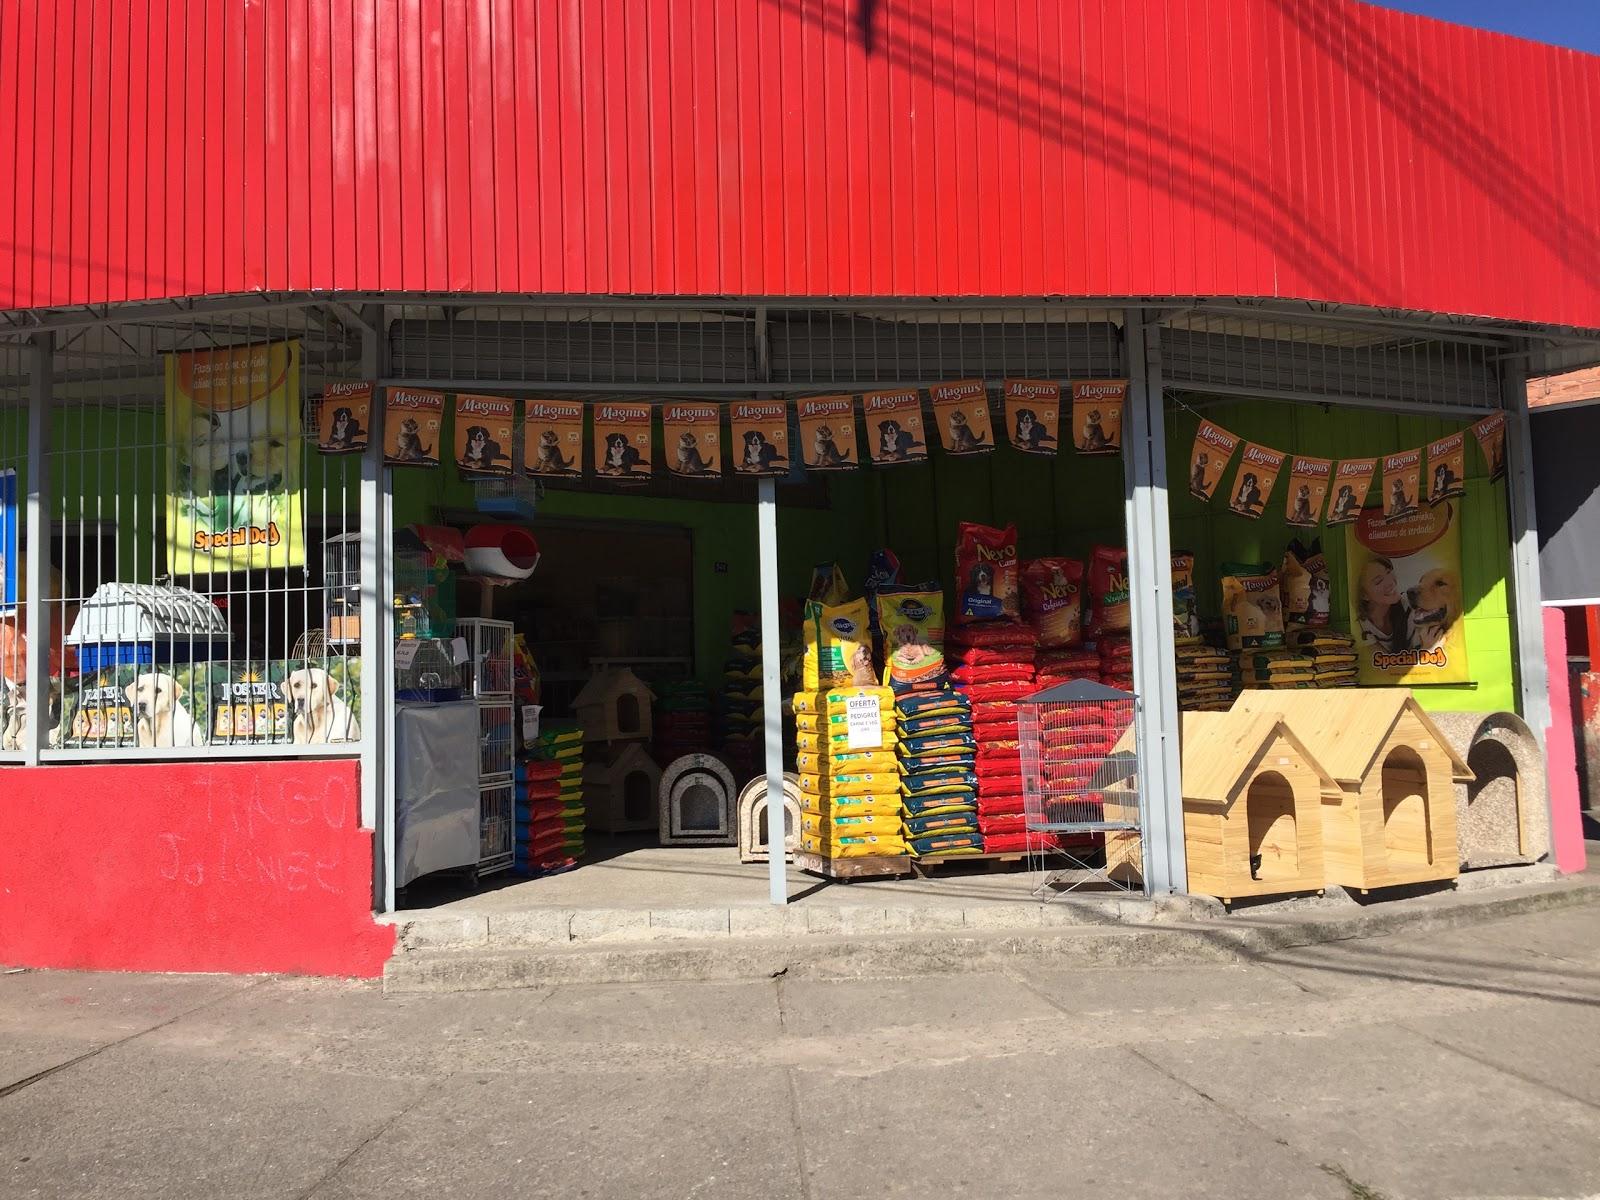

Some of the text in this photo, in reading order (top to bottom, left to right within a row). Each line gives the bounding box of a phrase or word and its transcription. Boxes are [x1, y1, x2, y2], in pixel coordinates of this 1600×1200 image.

[327, 382, 369, 397] Magnus
[934, 384, 982, 402] Magnus
[1006, 383, 1056, 399] Magnus
[1074, 384, 1122, 400] Magnus
[389, 391, 441, 408] Magnus
[458, 399, 511, 415] Magnus
[865, 394, 915, 411] Magnus
[527, 404, 579, 421] Magnus
[596, 407, 647, 422] Magnus
[665, 407, 716, 422] Magnus
[733, 405, 783, 420] Magnus
[799, 402, 849, 417] Magnus
[1197, 425, 1234, 448] Magnus
[1243, 447, 1281, 465] Magnus
[1428, 437, 1462, 459] Magnus
[1292, 459, 1328, 475] Magnus
[1336, 462, 1373, 476] Magnus
[1384, 453, 1418, 472] Magnus
[194, 522, 281, 552] Special Dog
[976, 543, 1017, 562] Nero
[1040, 583, 1078, 600] Nero
[968, 597, 994, 605] Original
[1373, 647, 1447, 669] Special Dog
[850, 711, 878, 719] PEDIGREE
